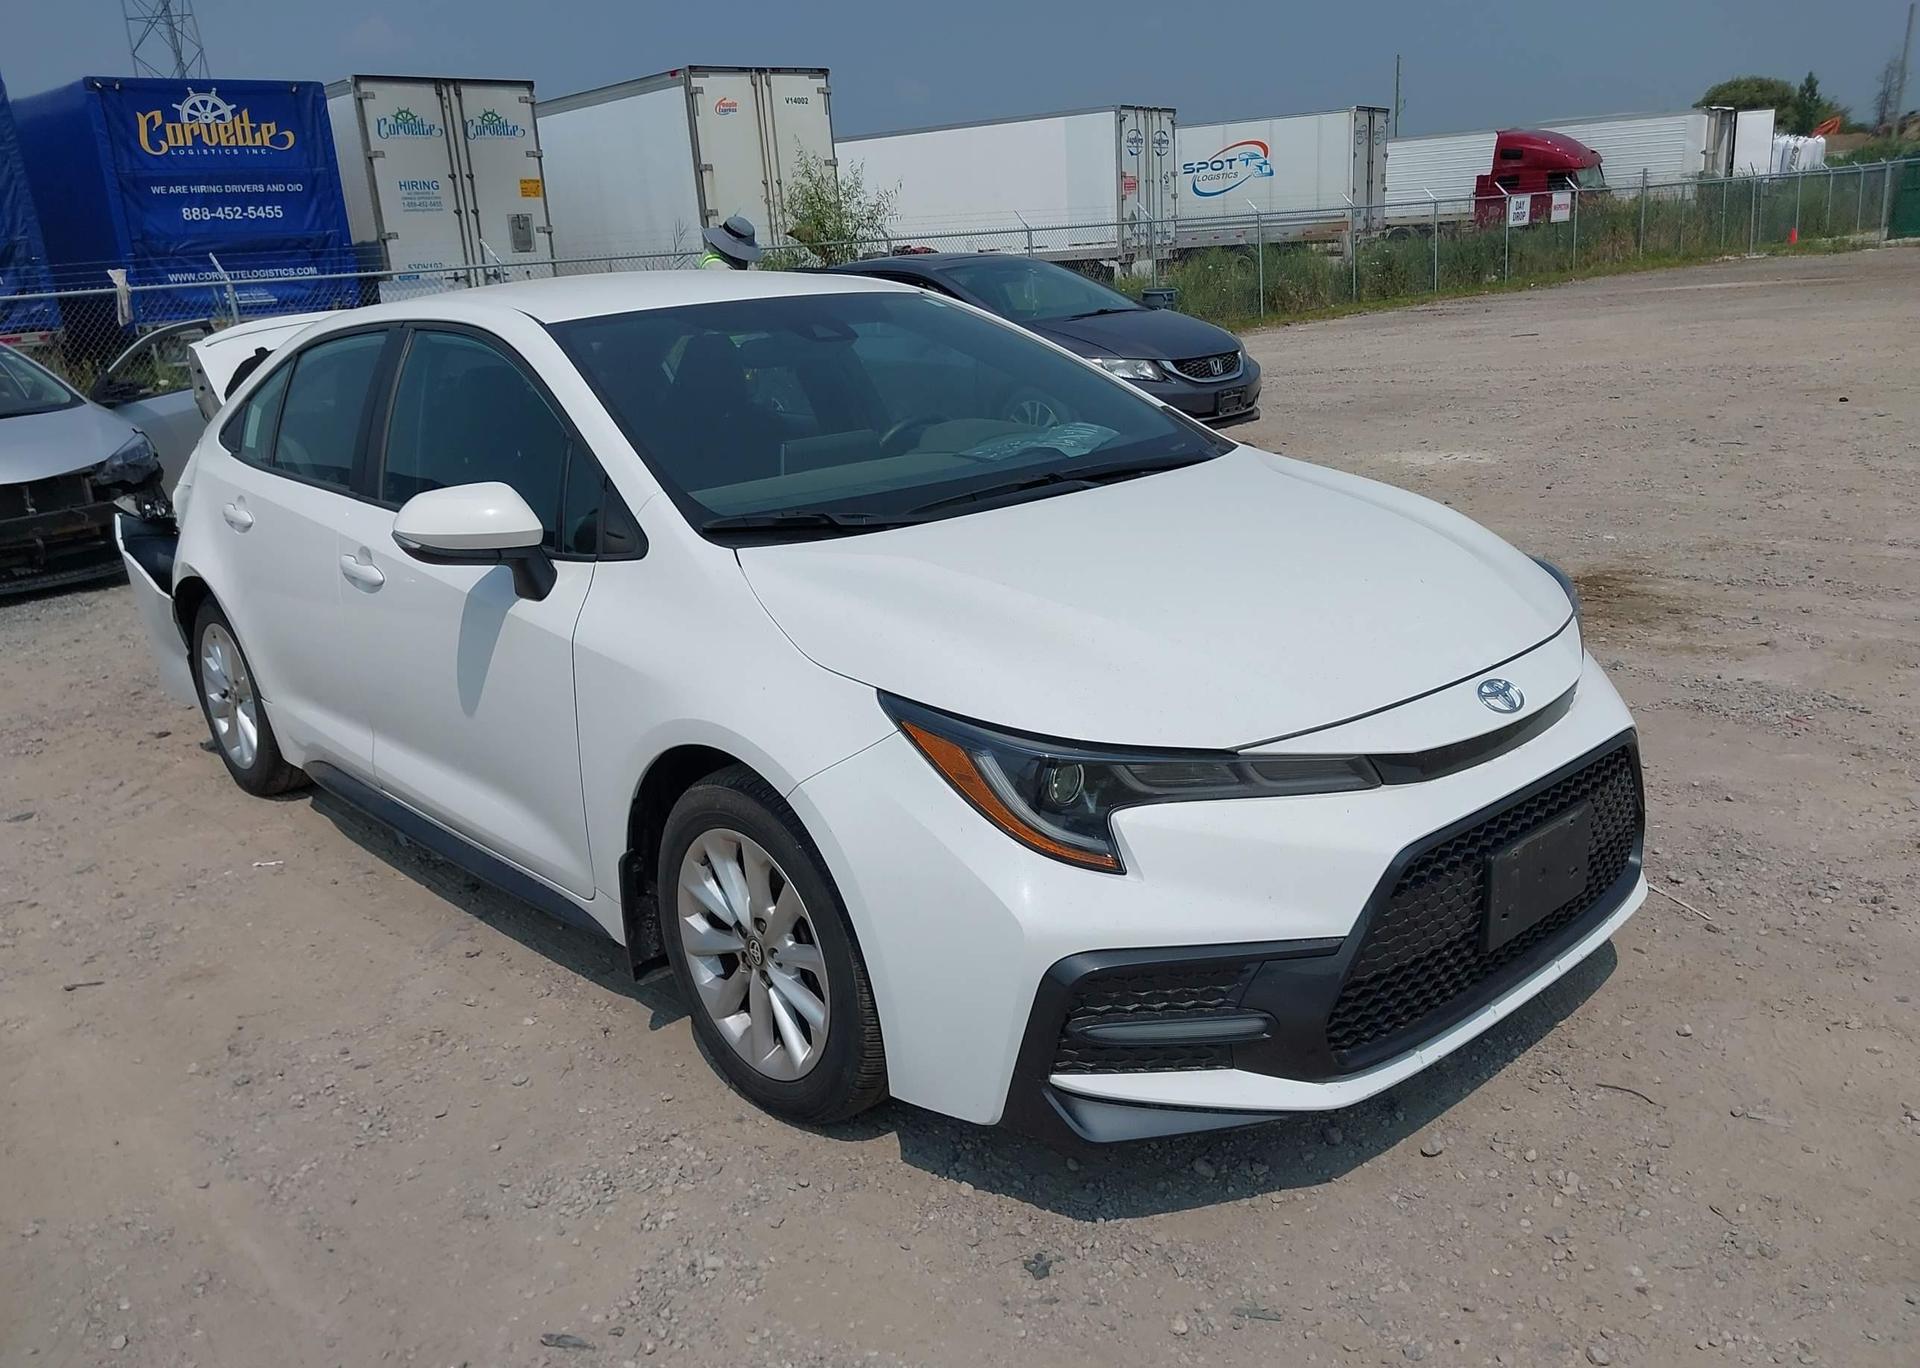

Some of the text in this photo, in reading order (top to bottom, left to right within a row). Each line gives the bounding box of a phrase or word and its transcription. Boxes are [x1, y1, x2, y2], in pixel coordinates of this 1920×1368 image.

[136, 108, 295, 156] Corvette
[376, 117, 443, 139] Corvette
[464, 118, 526, 140] Corvette
[170, 148, 273, 156] LOGISTICS INC.
[1182, 158, 1237, 174] SPOT
[1197, 172, 1238, 182] LOGISTICS
[150, 185, 167, 194] WE
[168, 185, 189, 194] ARE
[190, 184, 223, 194] HIRING
[224, 184, 265, 193] DRIVERS
[266, 183, 286, 192] AND
[399, 180, 440, 191] HIRING
[182, 205, 284, 221] 888-452-5455
[1512, 211, 1526, 221] DROP
